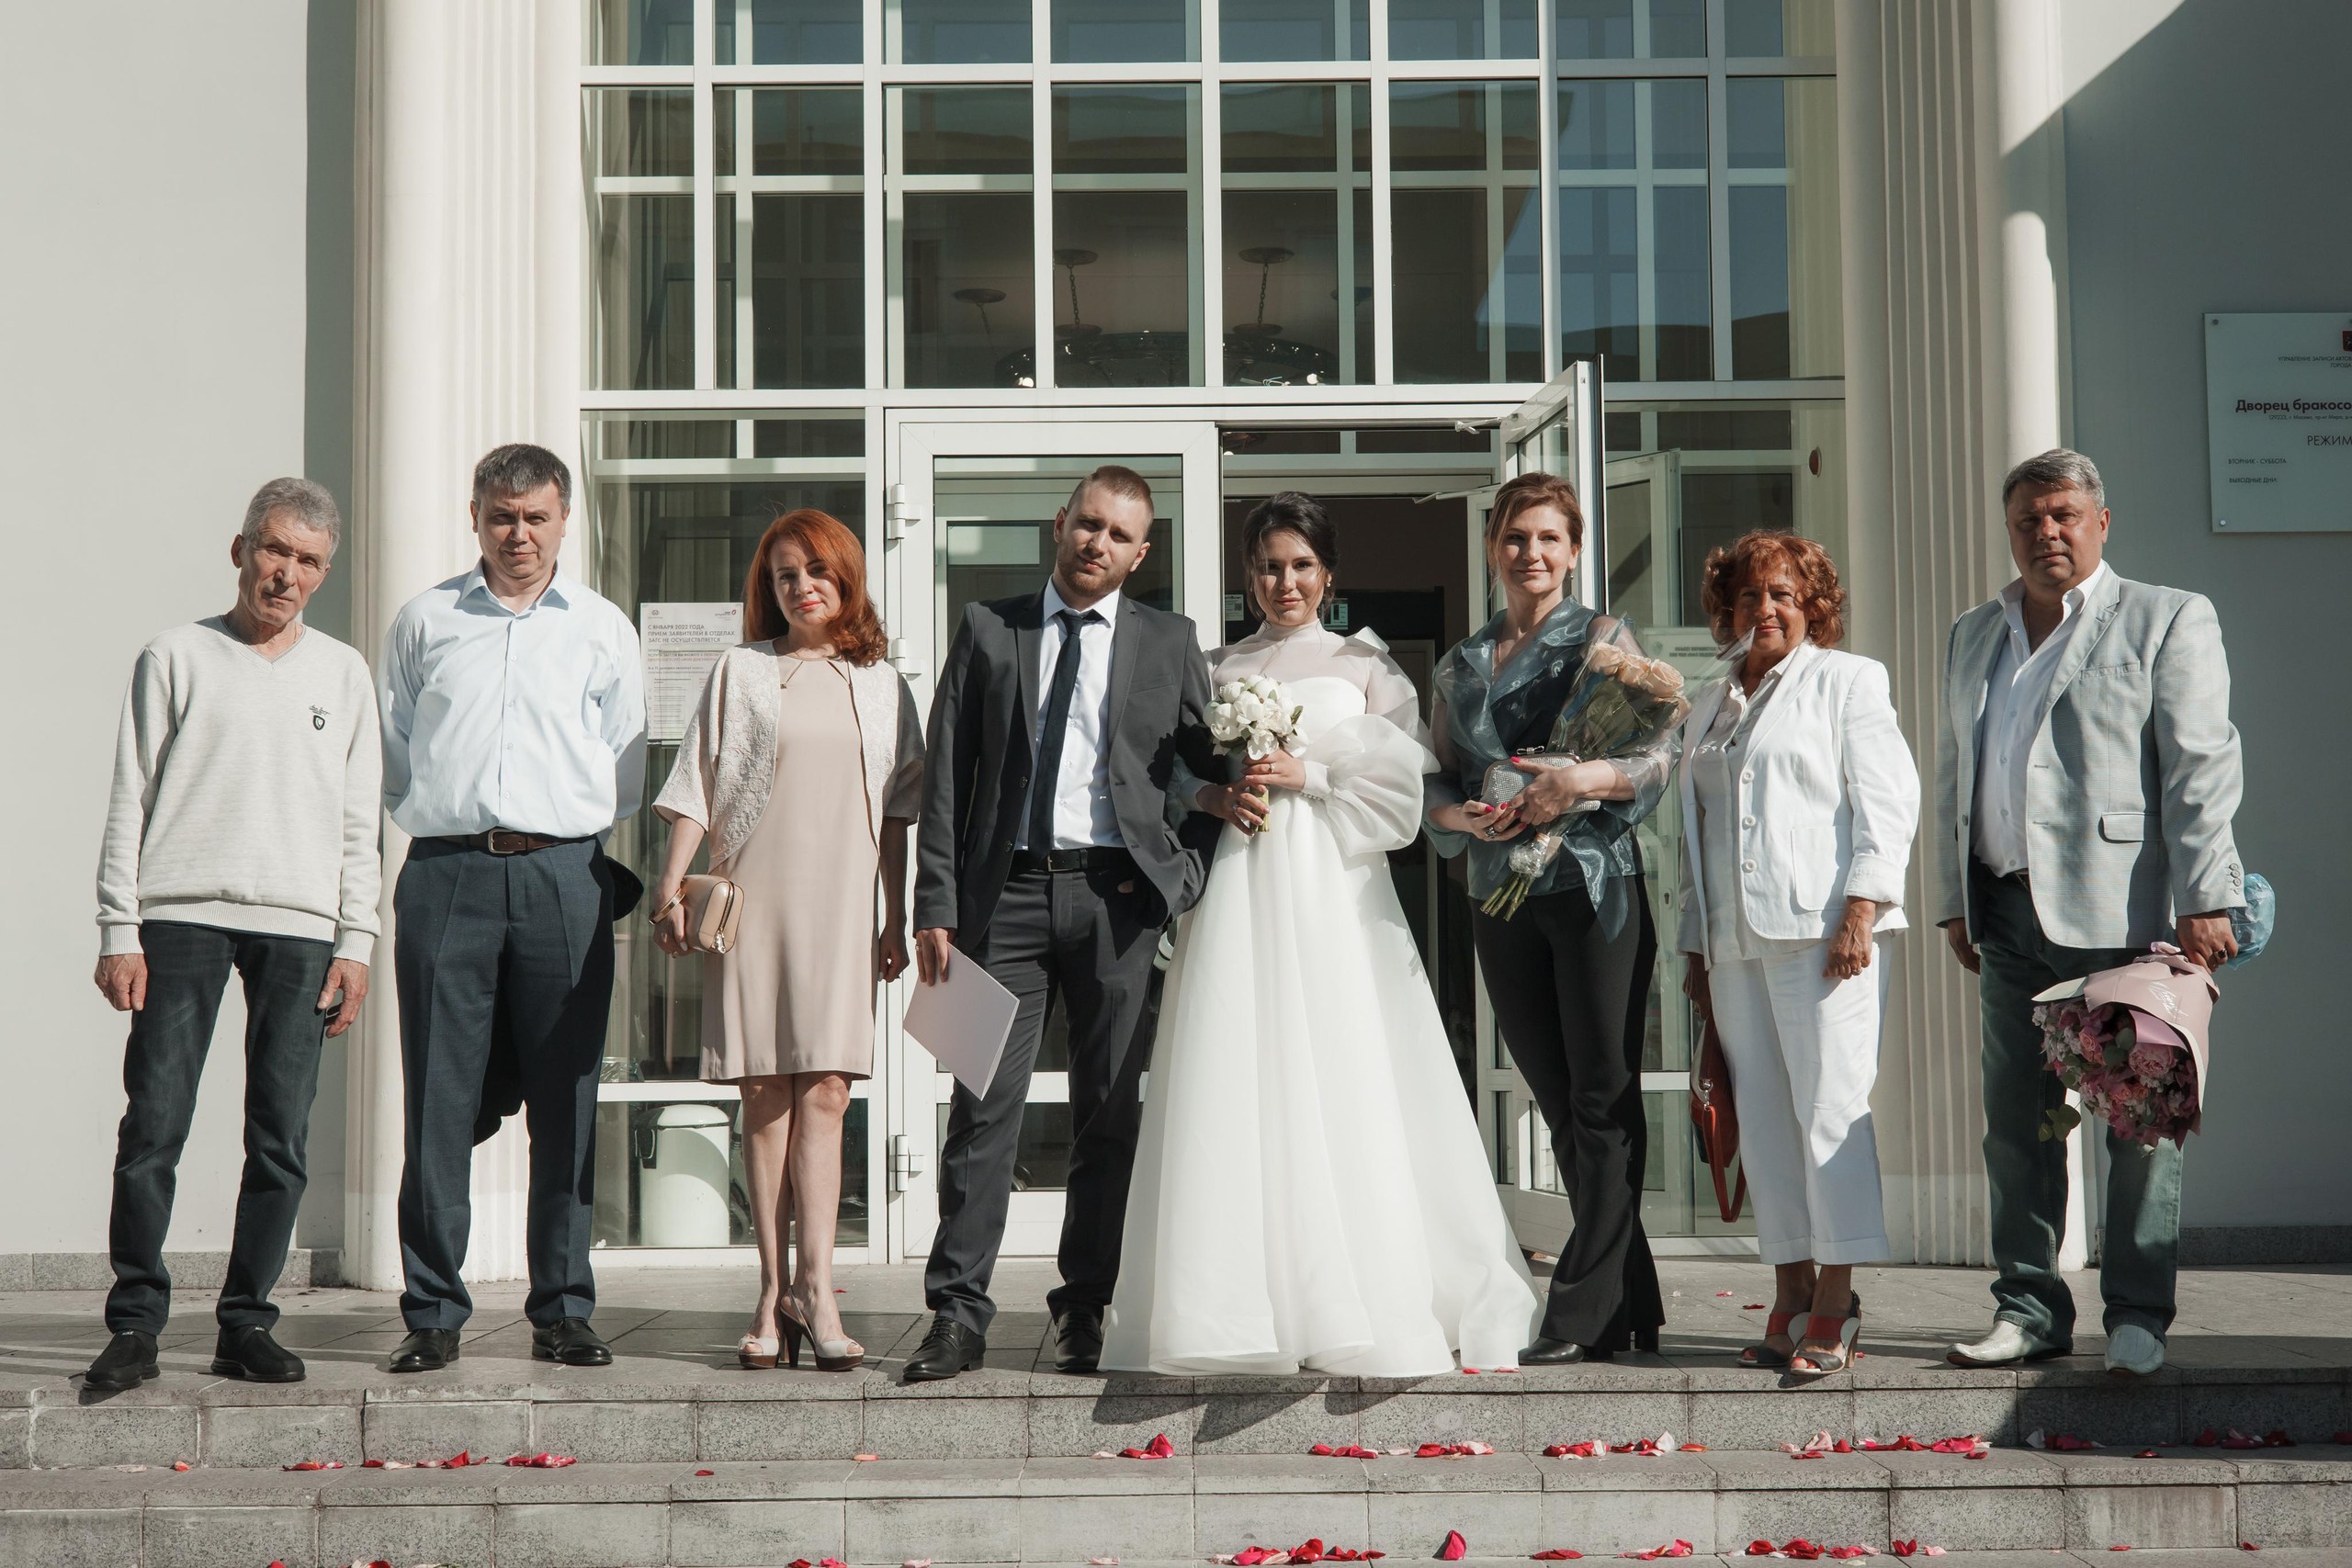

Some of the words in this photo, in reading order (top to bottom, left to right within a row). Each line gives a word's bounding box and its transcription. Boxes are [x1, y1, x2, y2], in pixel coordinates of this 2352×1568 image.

[2235, 400, 2290, 413] Дворец
[2293, 399, 2352, 413] бракосо
[2307, 434, 2352, 446] РЕЖИМ
